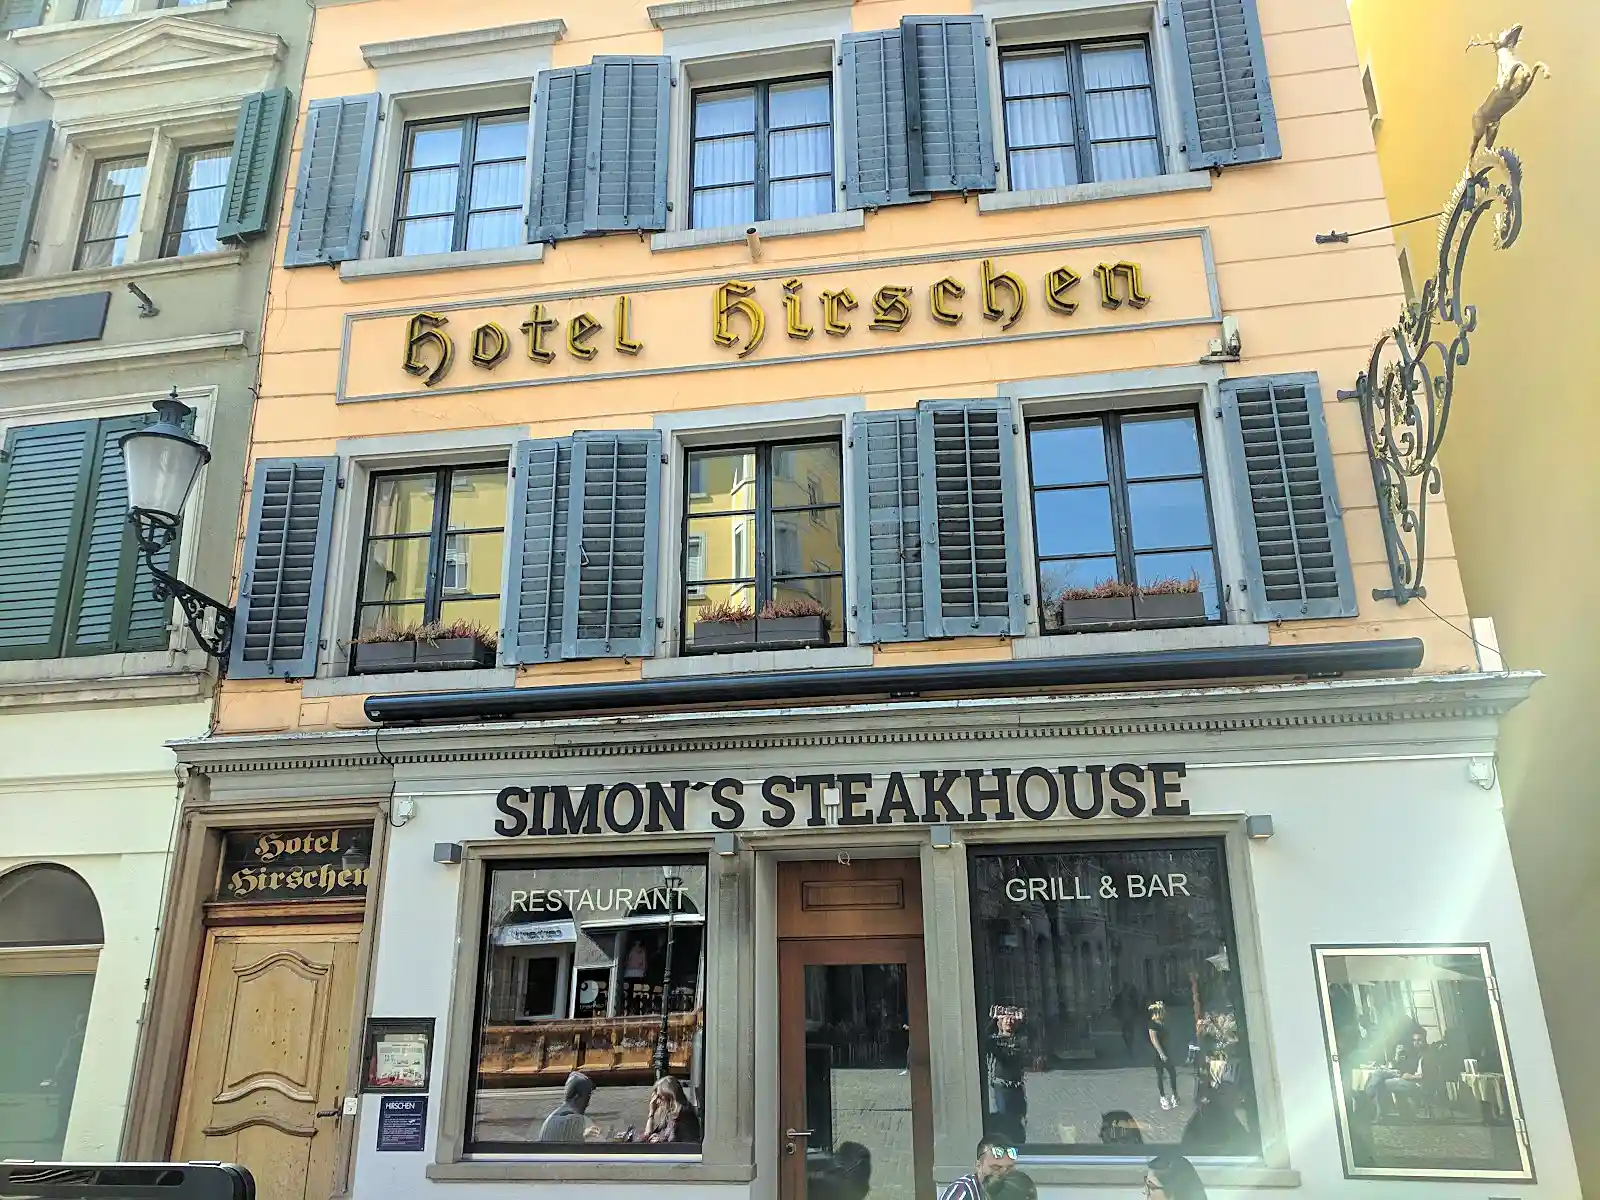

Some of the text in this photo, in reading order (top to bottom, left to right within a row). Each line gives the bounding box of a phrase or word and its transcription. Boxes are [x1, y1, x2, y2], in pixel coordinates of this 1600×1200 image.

[401, 258, 1151, 387] Hotel Hirschen
[762, 762, 1190, 828] STEAKHOUSE
[255, 829, 340, 863] Hotel
[510, 887, 689, 912] RESTAURANT
[1005, 873, 1191, 902] GRILL & BAR
